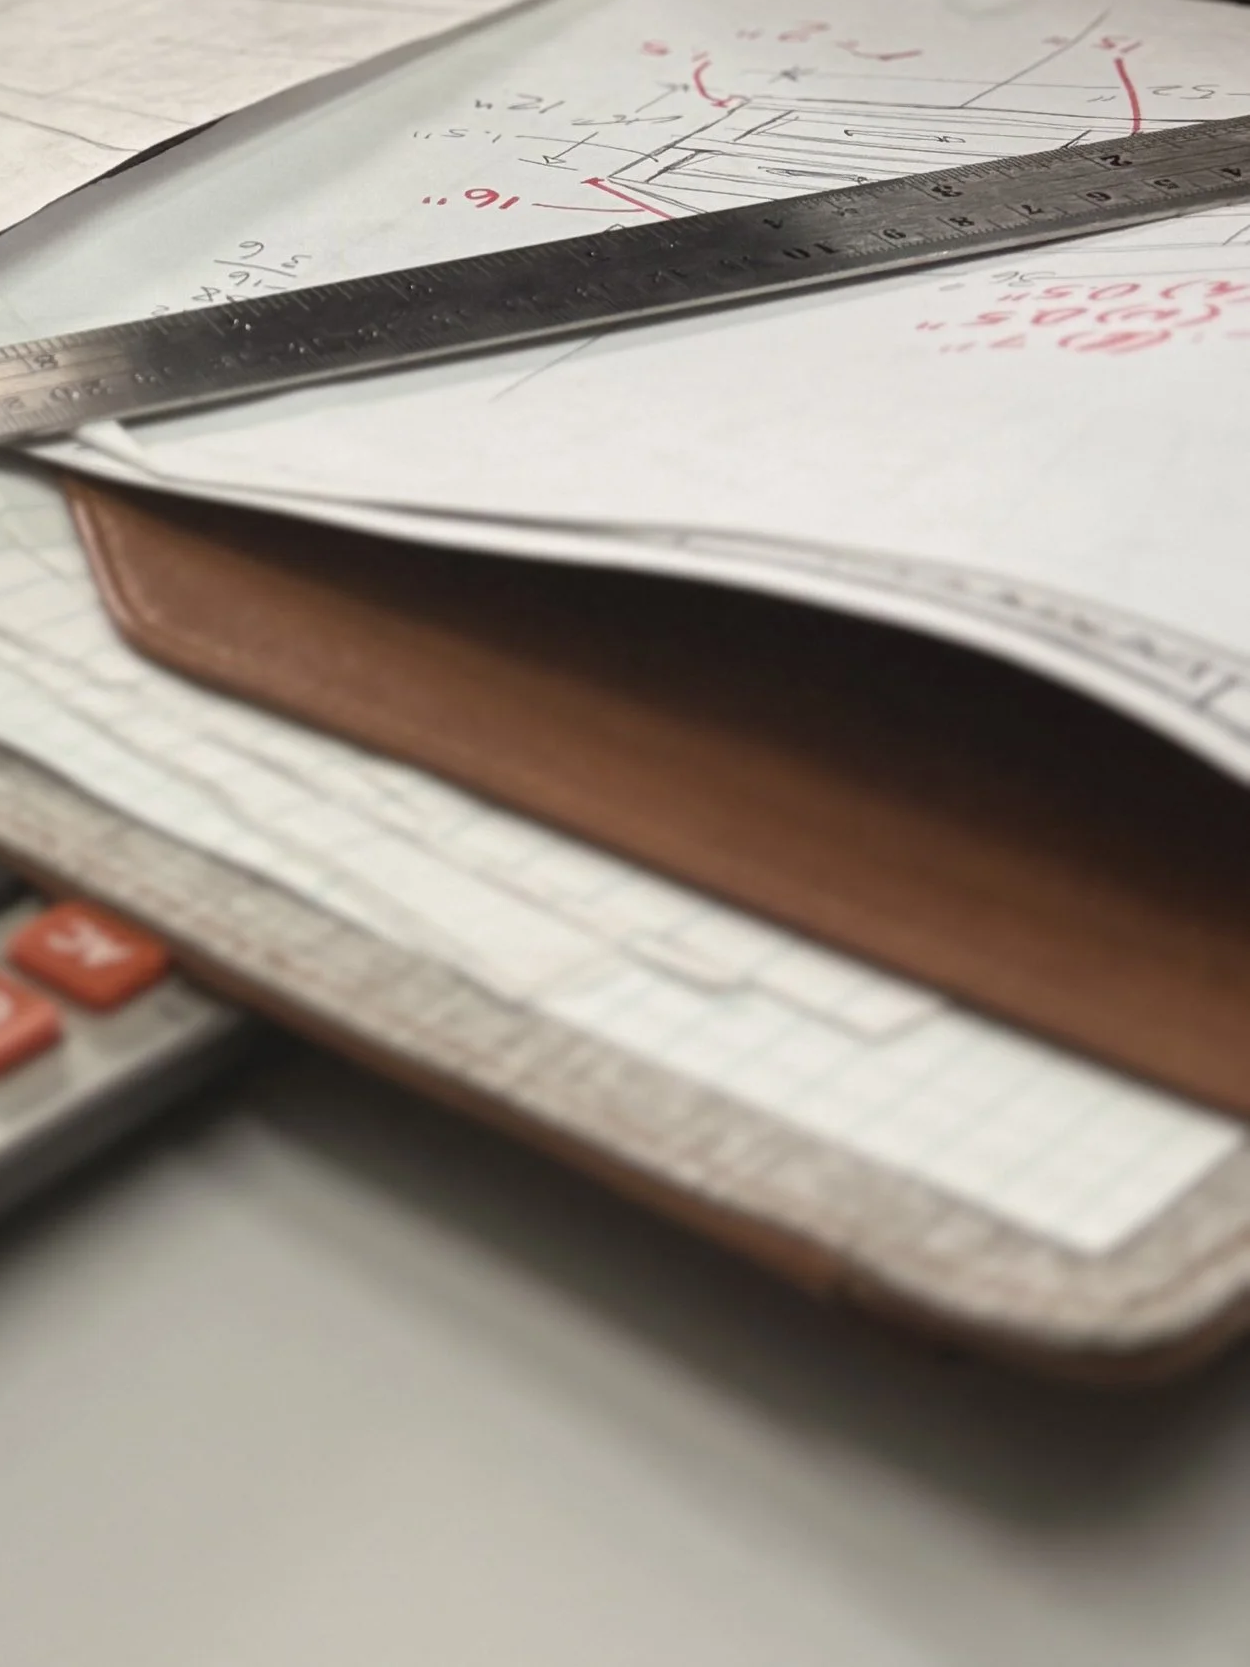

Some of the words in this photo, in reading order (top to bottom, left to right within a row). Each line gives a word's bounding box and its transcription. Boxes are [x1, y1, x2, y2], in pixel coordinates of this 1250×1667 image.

[1100, 155, 1133, 168] 2
[1154, 178, 1180, 190] 5
[931, 186, 961, 199] 3
[1086, 192, 1112, 203] 6
[422, 189, 521, 210] 16"
[1021, 204, 1043, 215] 7
[950, 217, 975, 228] 8
[883, 229, 906, 240] 9
[782, 243, 839, 260] 10
[43, 918, 133, 969] AC
